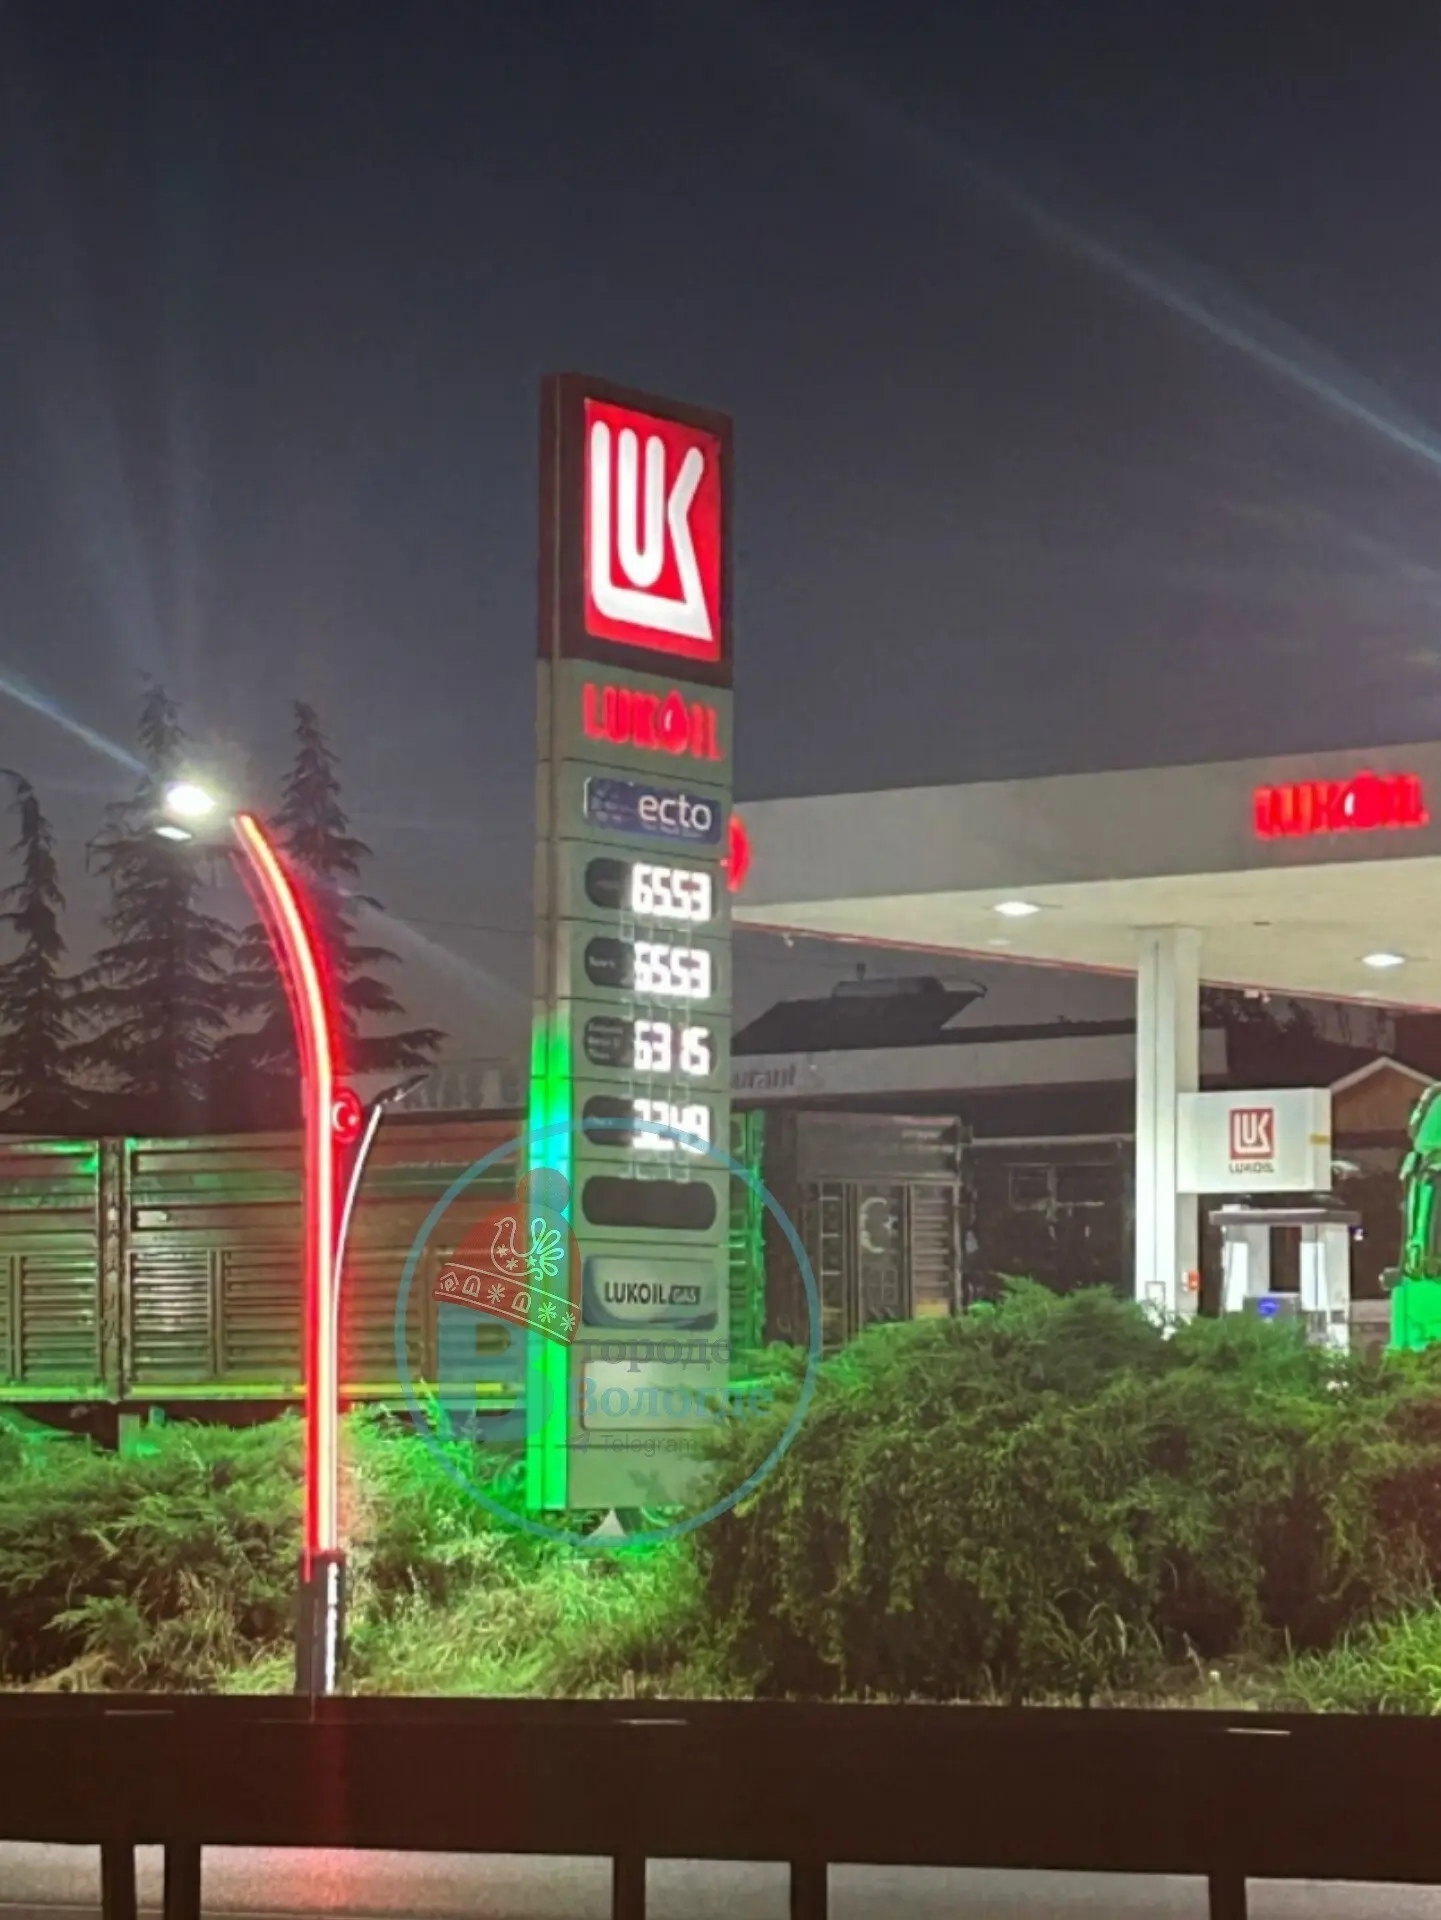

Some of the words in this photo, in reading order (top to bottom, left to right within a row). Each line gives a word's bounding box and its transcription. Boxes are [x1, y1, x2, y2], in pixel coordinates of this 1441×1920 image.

[581, 682, 724, 761] LUKOIL
[638, 794, 712, 831] ecto
[1253, 768, 1429, 841] LUKOIL
[604, 1281, 666, 1305] LUKOIL
